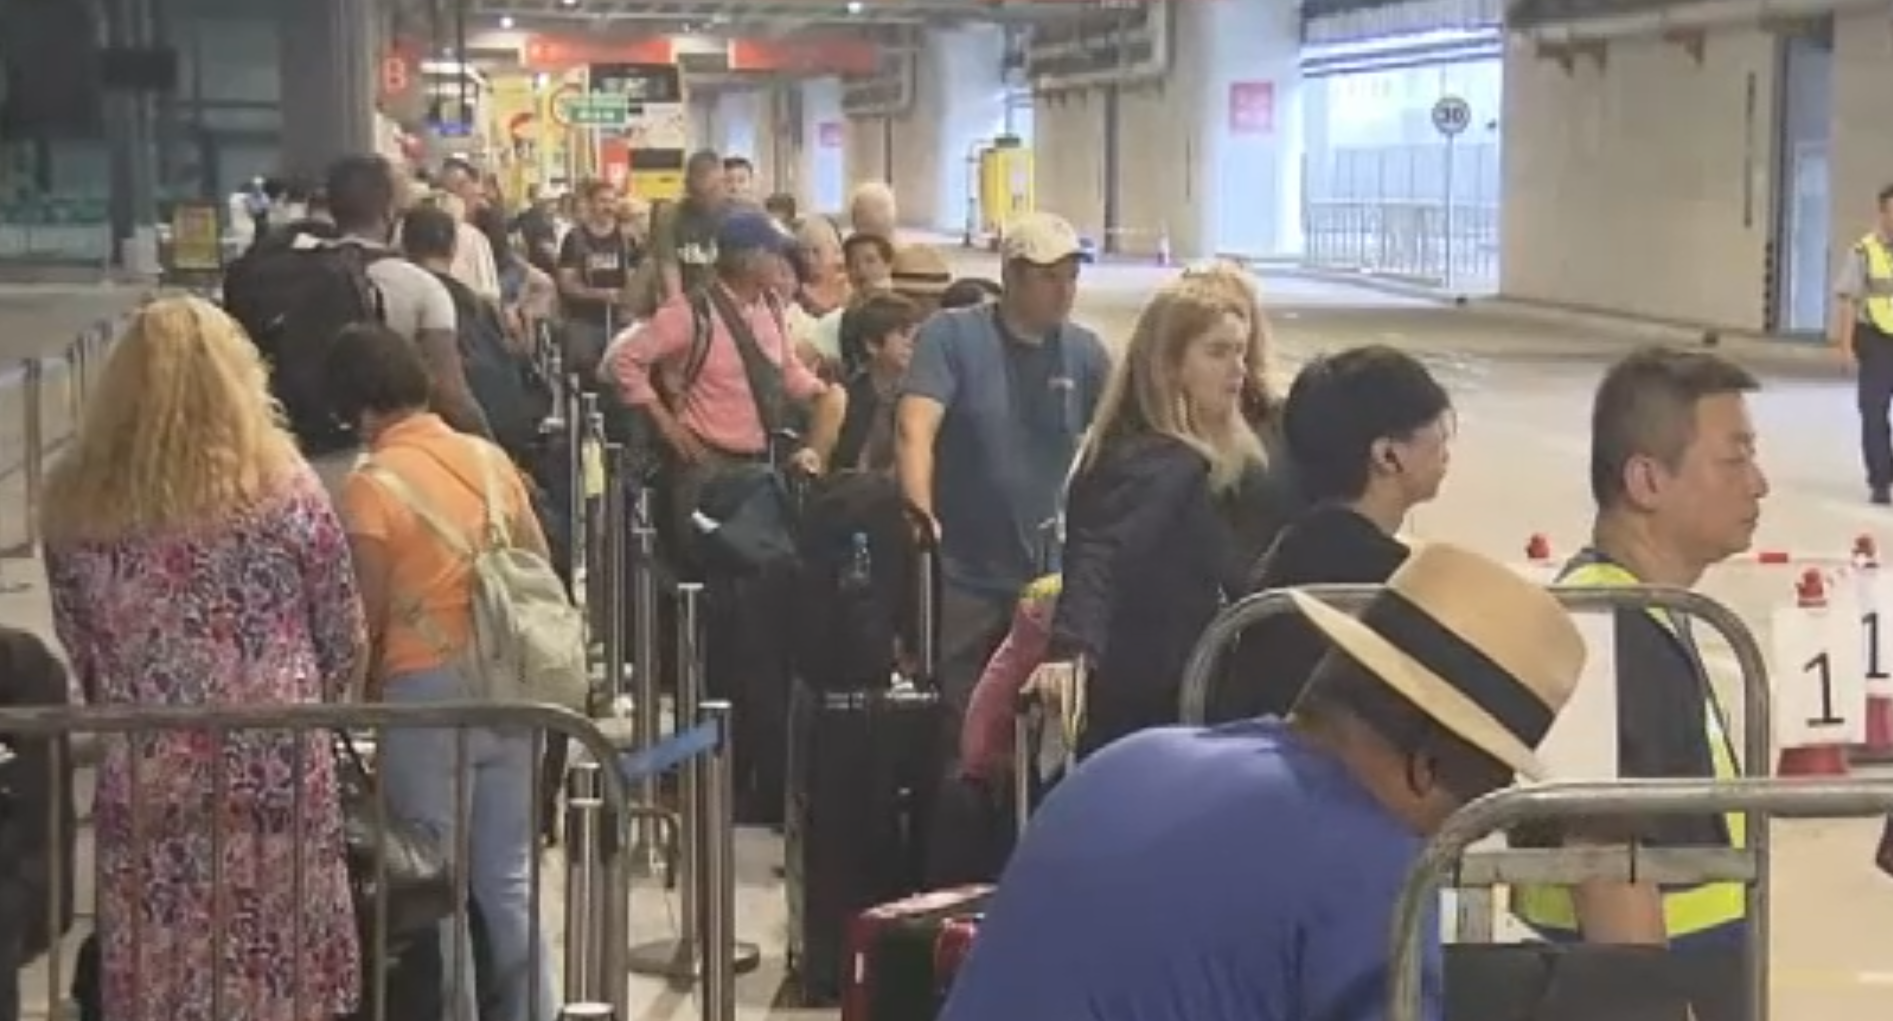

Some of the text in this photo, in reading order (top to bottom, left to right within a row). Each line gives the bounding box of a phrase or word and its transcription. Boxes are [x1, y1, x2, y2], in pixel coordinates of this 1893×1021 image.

[1439, 107, 1464, 123] 30
[1861, 611, 1891, 679] 1
[1804, 651, 1845, 728] 1
